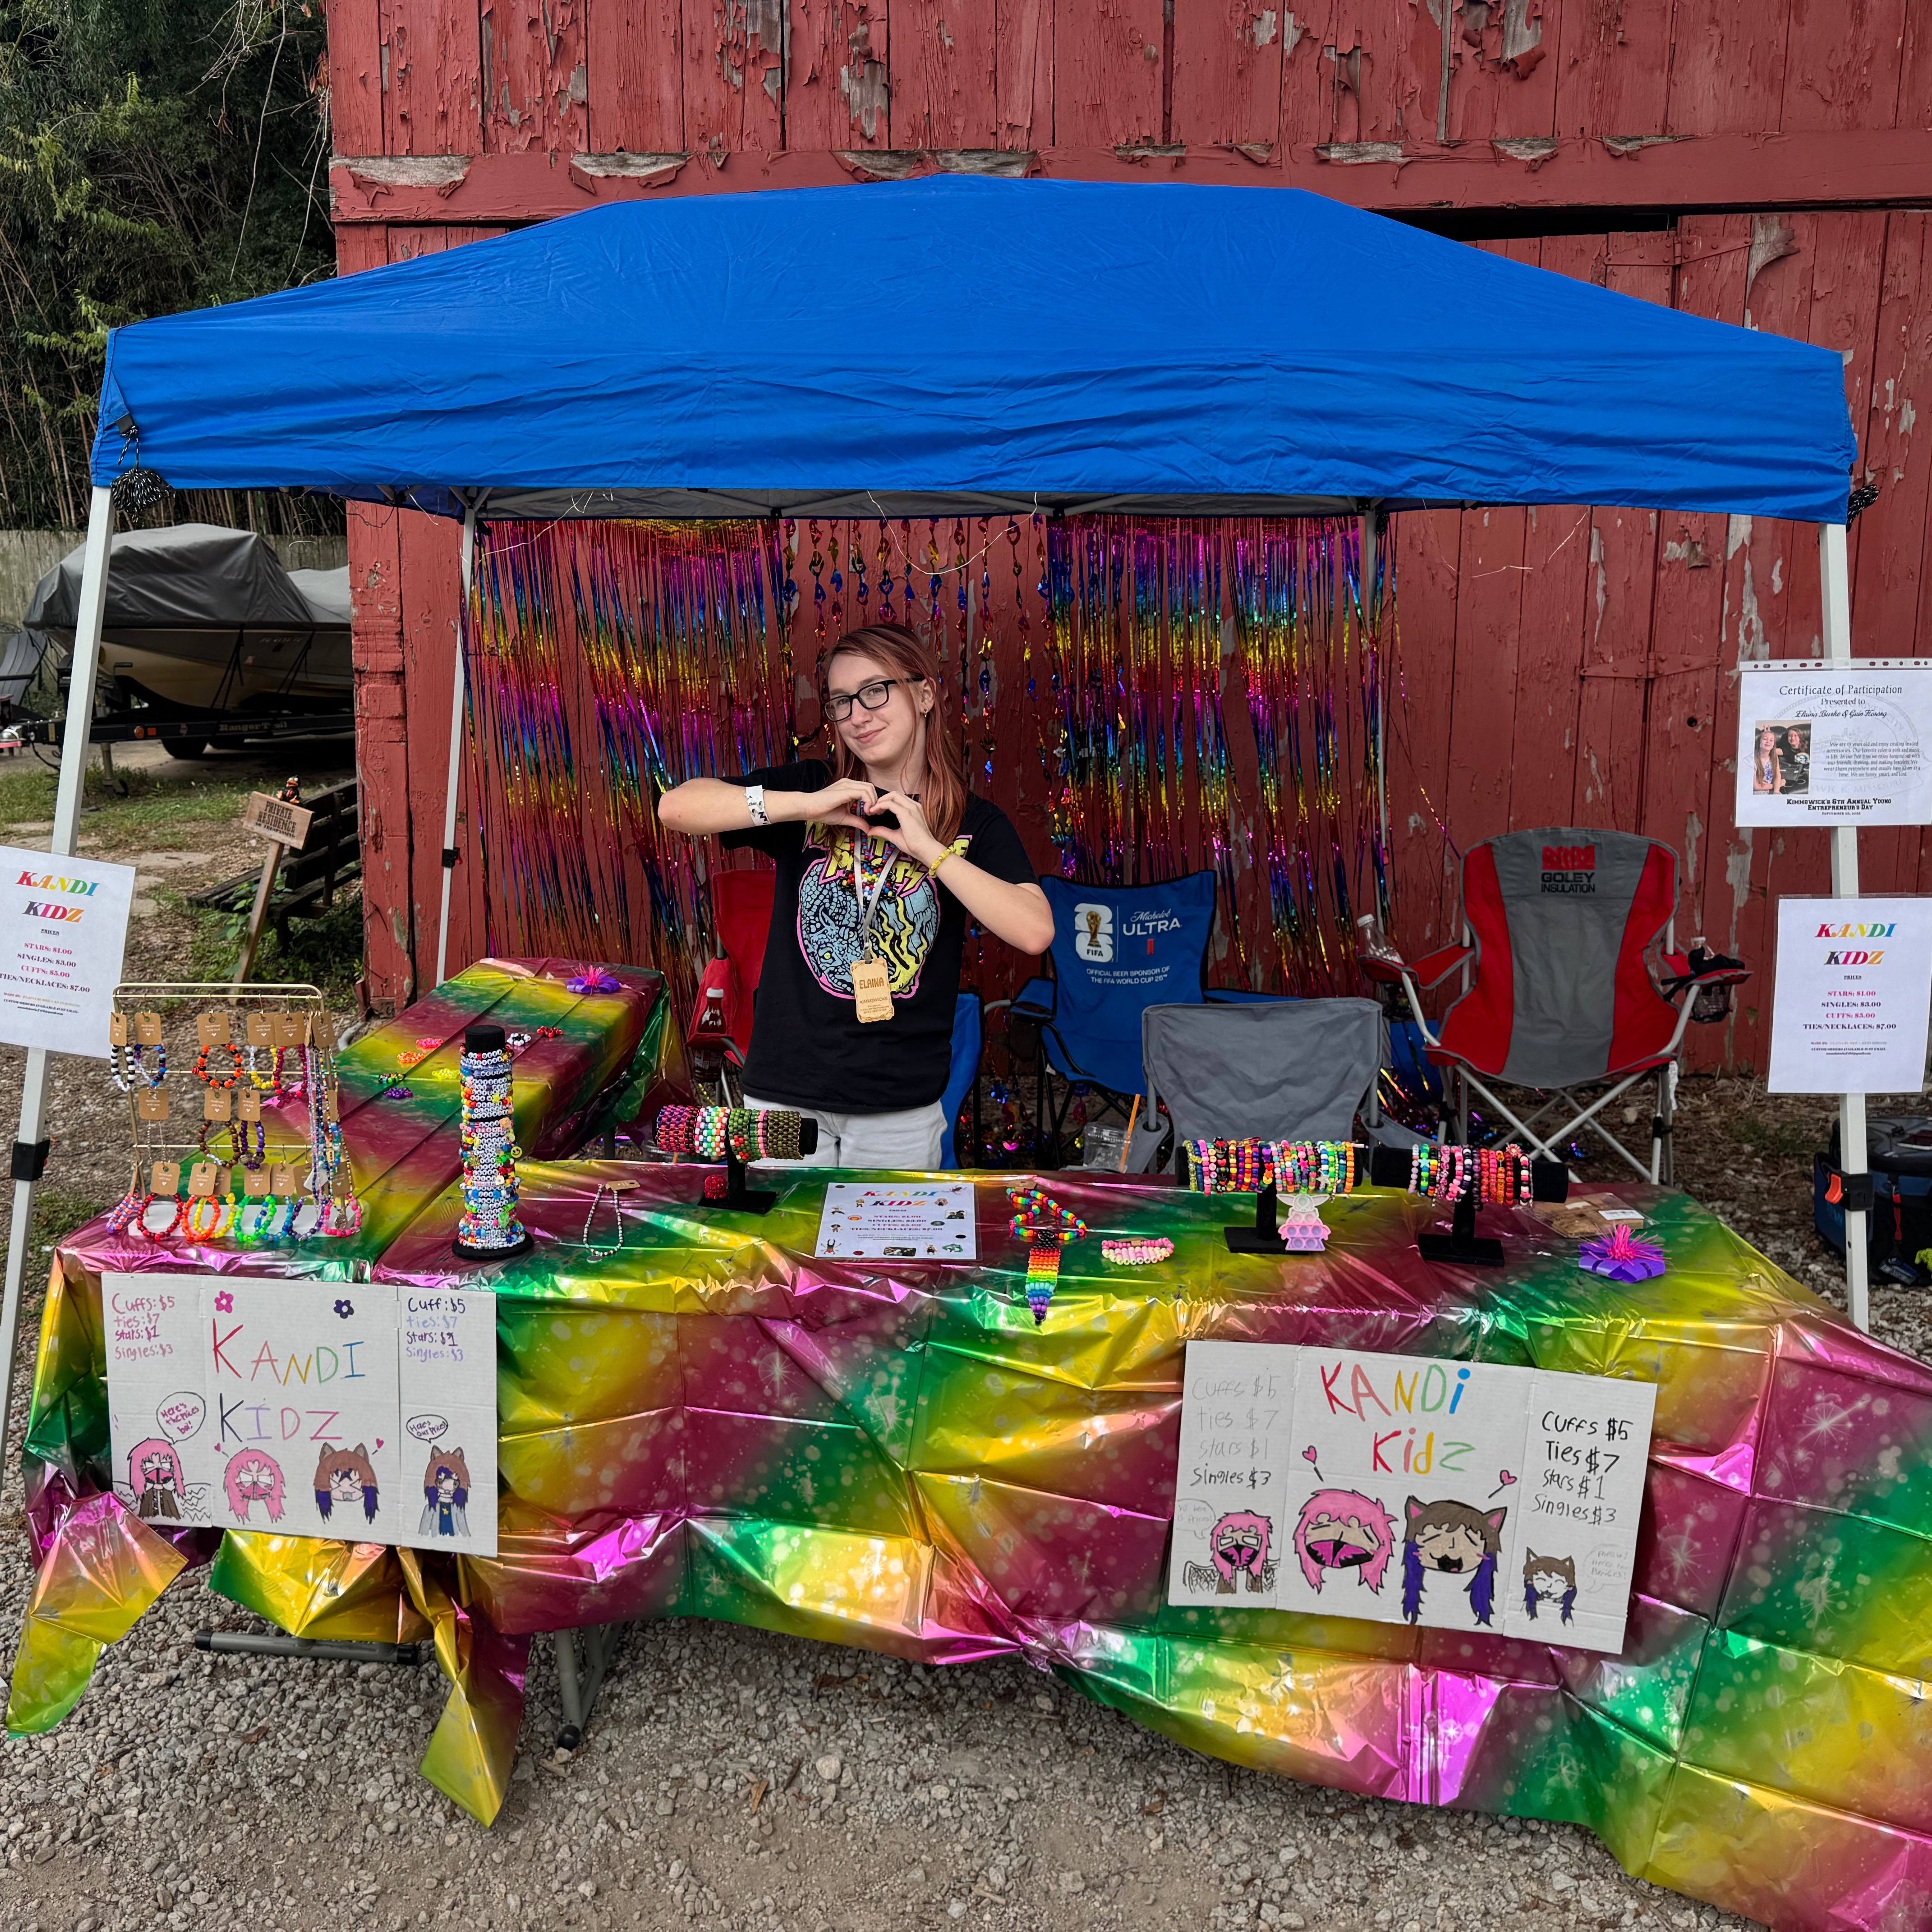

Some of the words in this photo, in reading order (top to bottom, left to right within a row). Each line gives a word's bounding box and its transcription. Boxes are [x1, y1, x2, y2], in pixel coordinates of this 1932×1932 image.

[1779, 685, 1831, 696] Certificate
[1835, 685, 1845, 695] of
[1848, 685, 1902, 695] Participation
[262, 721, 288, 729] Tail
[265, 801, 293, 820] PRIVATE
[257, 811, 297, 833] RESIDENCE
[15, 871, 100, 897] KANDI
[1541, 872, 1595, 883] GOLEY
[1541, 884, 1595, 893] INSULATION
[22, 901, 84, 923] KIDZ
[1130, 908, 1171, 923] Michelob
[1123, 918, 1181, 936] ULTRA
[1814, 923, 1898, 938] KANDI
[1086, 949, 1104, 957] FIFA
[1823, 951, 1885, 965] KIDZ
[1086, 968, 1112, 976] OFFICIAL
[1130, 968, 1160, 977] SPONSOR
[859, 977, 884, 989] ELAINA
[213, 1318, 366, 1386] KANDI
[220, 1392, 343, 1443] KIDZ
